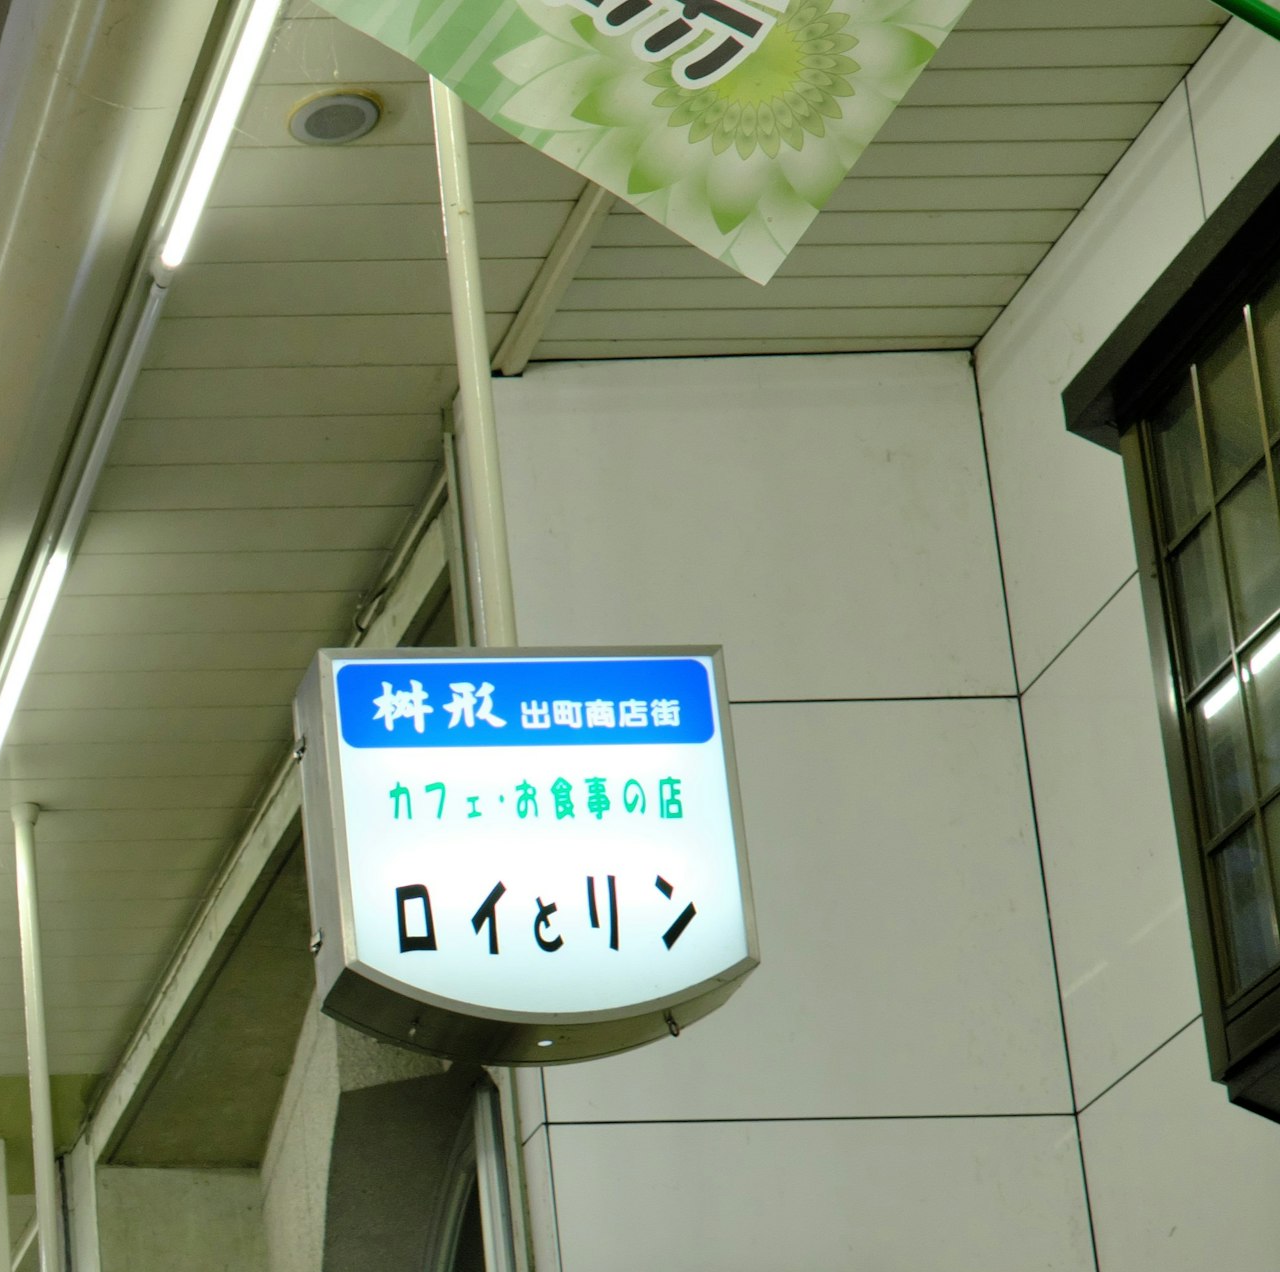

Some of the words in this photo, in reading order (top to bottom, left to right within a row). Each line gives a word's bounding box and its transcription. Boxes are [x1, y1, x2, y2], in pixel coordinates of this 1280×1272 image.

[520, 699, 681, 730] 出町商店街
[389, 777, 684, 820] カフェ・お食事の店
[396, 875, 697, 955] ロイとリン
